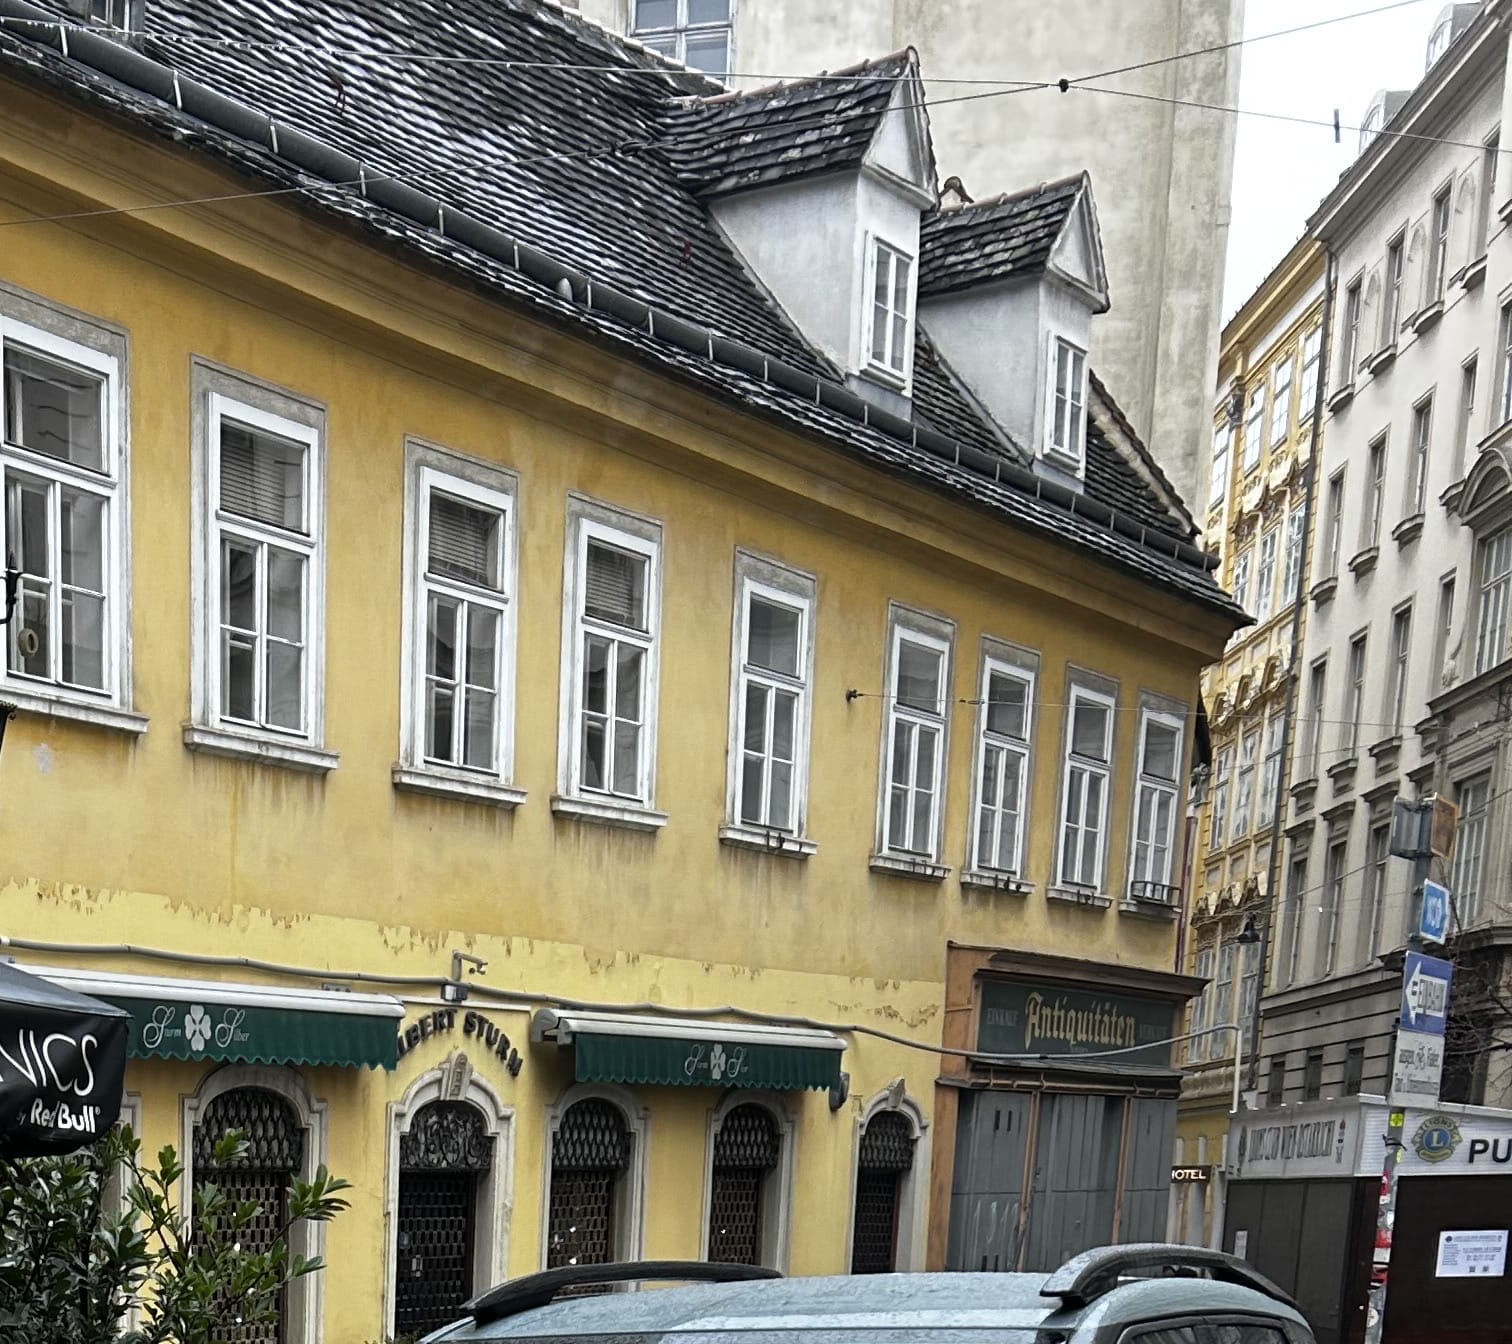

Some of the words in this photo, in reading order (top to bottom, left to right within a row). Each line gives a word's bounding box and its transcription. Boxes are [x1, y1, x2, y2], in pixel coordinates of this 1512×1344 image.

[397, 1008, 457, 1060] LBERT
[463, 1011, 523, 1077] STURM
[1025, 991, 1135, 1050] Antiquitäten
